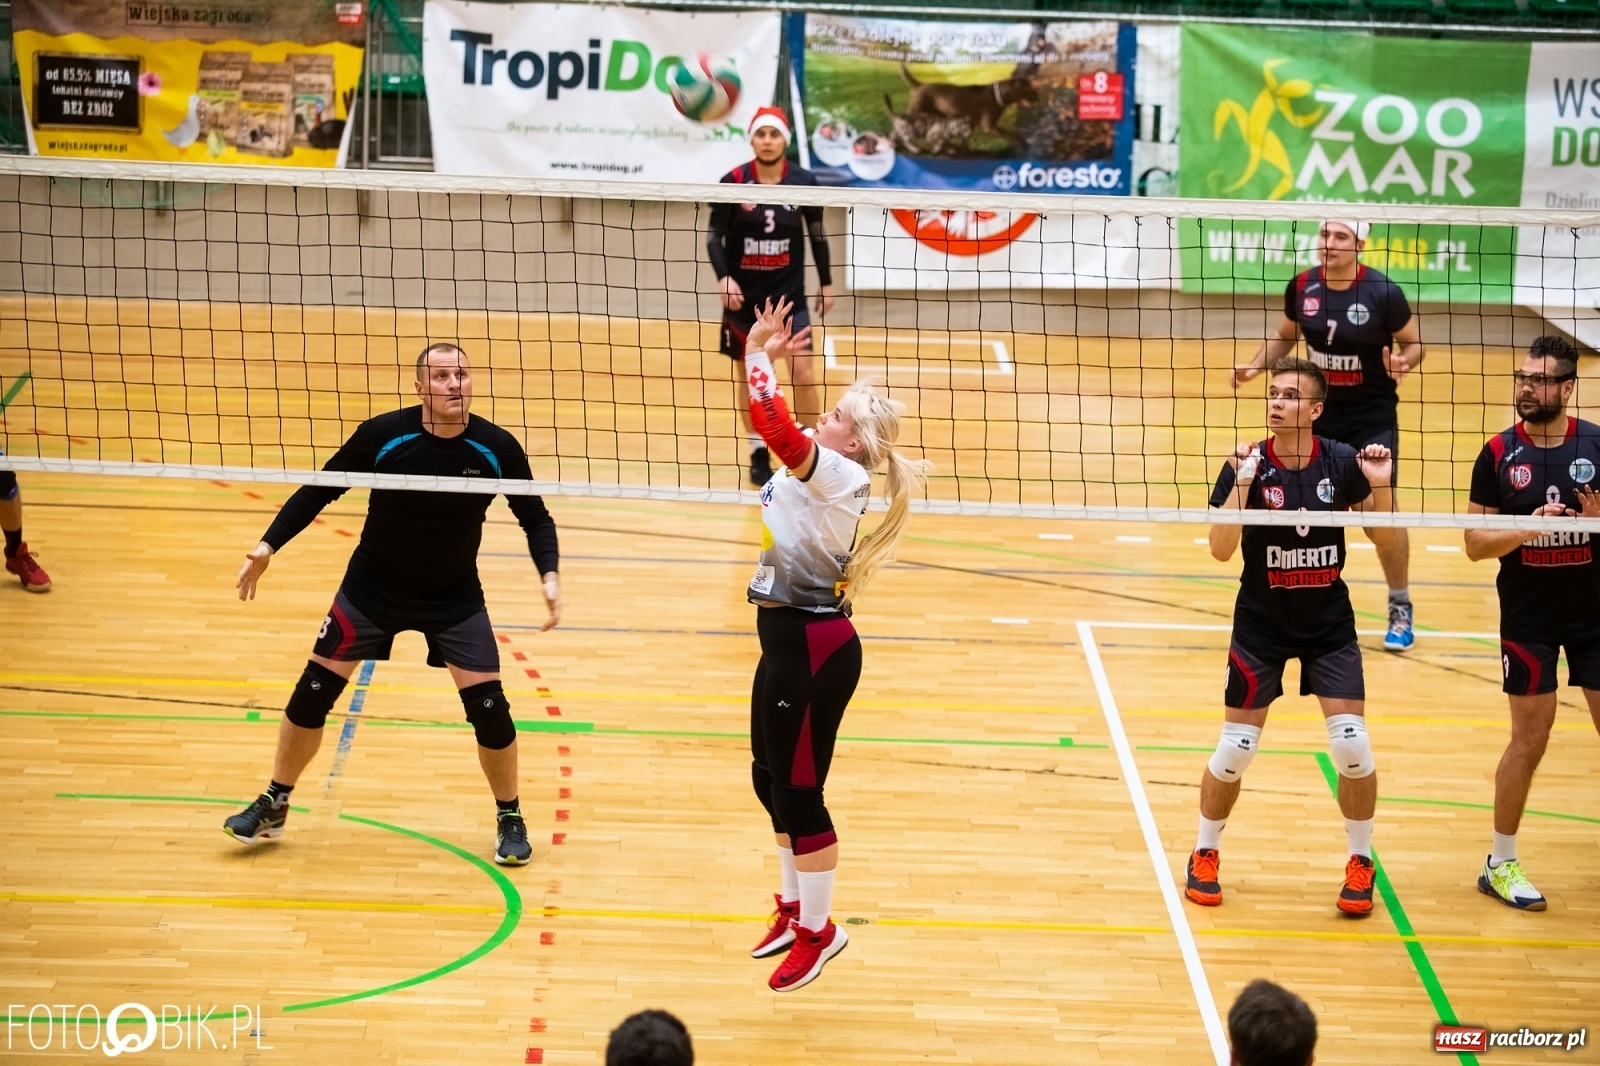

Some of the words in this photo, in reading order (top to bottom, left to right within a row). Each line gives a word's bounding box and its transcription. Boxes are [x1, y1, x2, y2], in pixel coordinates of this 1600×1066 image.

[129, 4, 189, 24] Wiejska
[193, 8, 252, 26] zagroda
[451, 29, 736, 100] TropiDo
[45, 68, 59, 80] od
[95, 67, 131, 88] MIĘSA
[1094, 71, 1108, 93] 8
[62, 99, 84, 116] BEZ
[1313, 90, 1482, 148] ZOO
[1018, 162, 1122, 189] foresto
[1295, 140, 1476, 198] MAR
[764, 209, 776, 233] 3
[1207, 229, 1472, 273] WWW.ZOMAR.PL
[1326, 319, 1338, 346] 7
[1522, 531, 1591, 548] MERTA
[1266, 545, 1339, 570] OMERTA
[1267, 567, 1340, 588] NORTHERN
